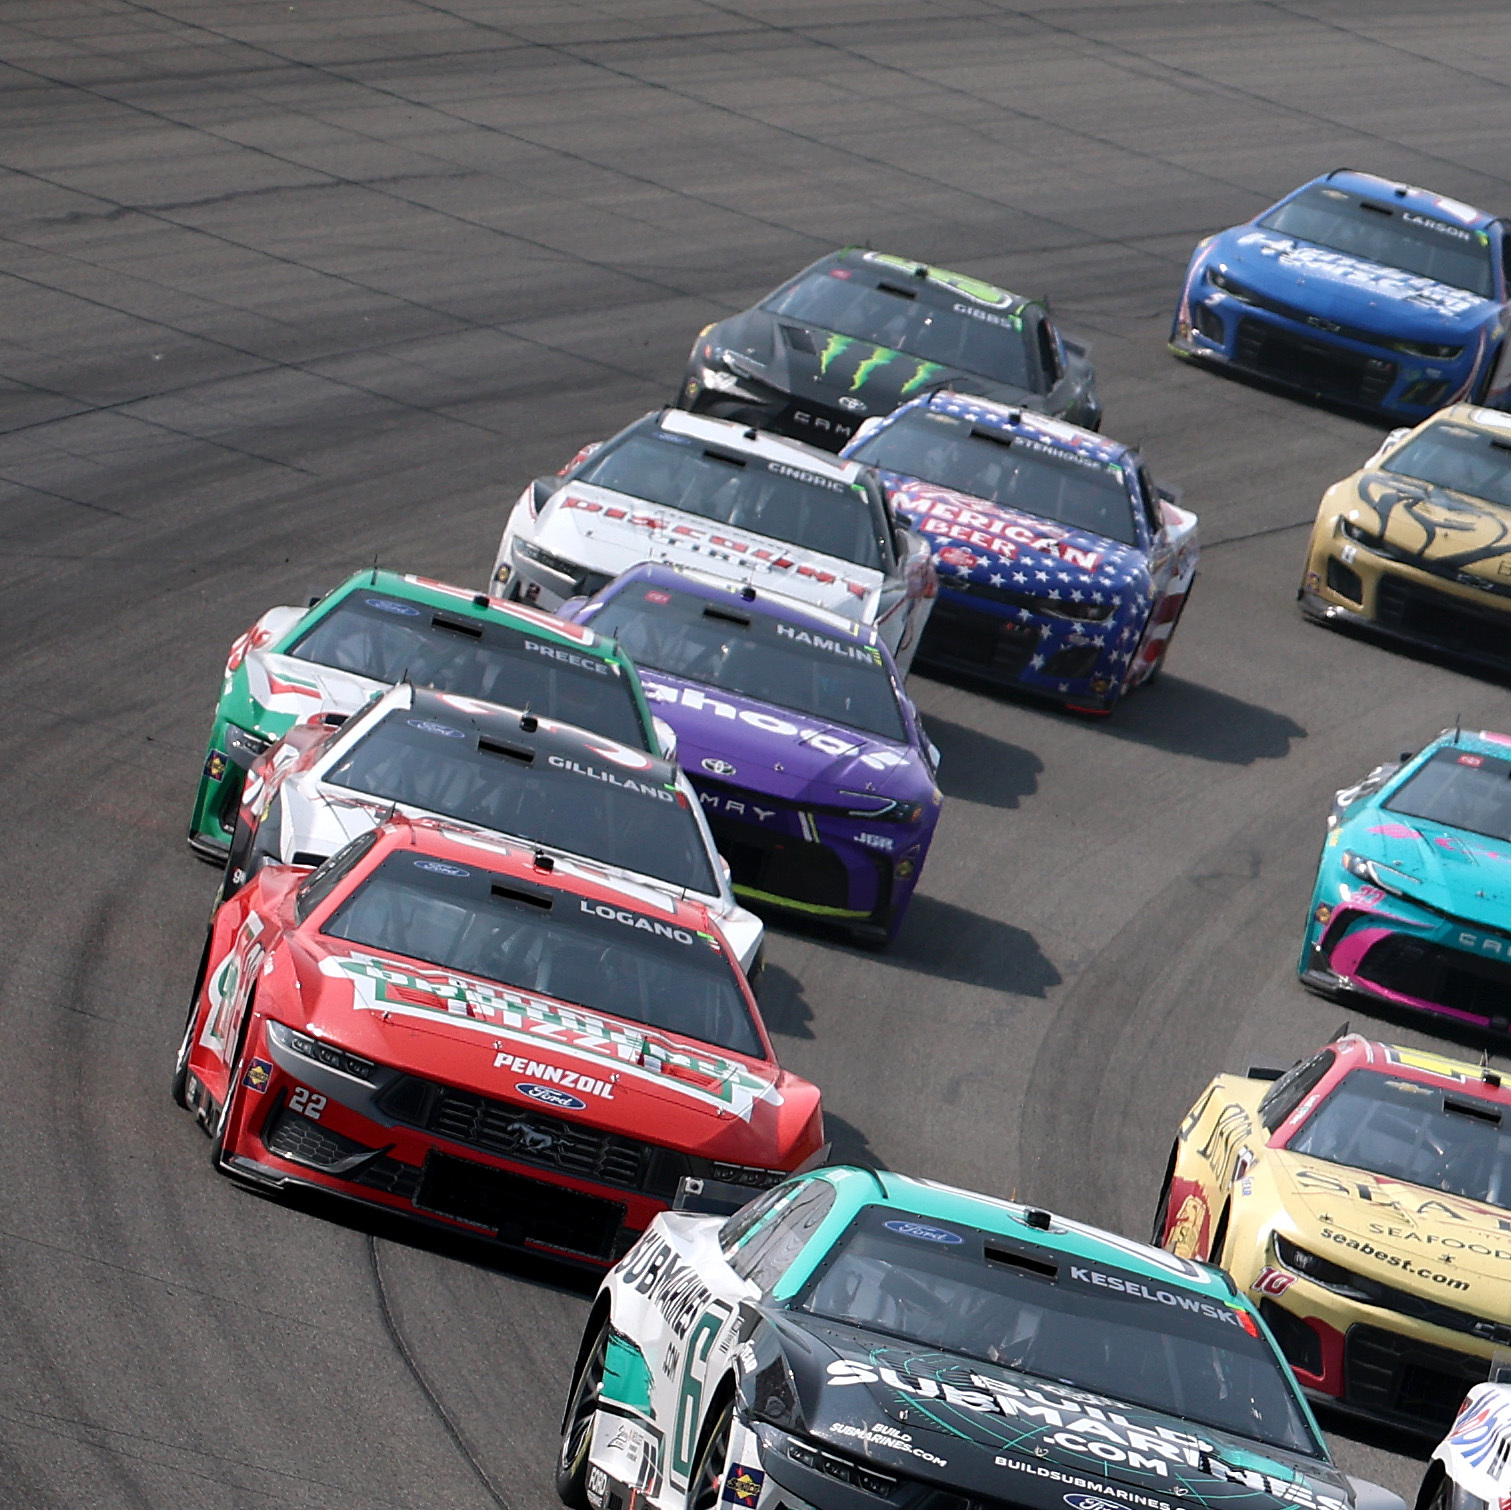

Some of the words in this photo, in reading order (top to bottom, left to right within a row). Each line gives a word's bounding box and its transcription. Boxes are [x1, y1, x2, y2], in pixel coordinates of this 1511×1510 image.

[1402, 211, 1470, 240] LARSON
[953, 303, 1012, 329] GIBBS
[794, 411, 853, 436] CAM
[767, 461, 845, 494] CINDRIC
[924, 518, 1018, 556] BEER
[524, 639, 609, 675] PREECE
[776, 624, 873, 664] HAMLIN
[548, 755, 674, 802] GILLILAND
[700, 793, 776, 821] MRY
[580, 899, 693, 946] LOGANO
[493, 1052, 616, 1100] PENNZOIL
[288, 1086, 328, 1120] 22
[1320, 1226, 1471, 1292] seabest.com
[1070, 1265, 1245, 1329] KESELOWSKI
[1249, 1265, 1300, 1299] 10
[671, 1298, 728, 1492] 6
[970, 1371, 1214, 1454] BUILD
[829, 1422, 948, 1469] SUBMARINES.COM
[871, 1421, 913, 1444] BUILD
[1043, 1429, 1169, 1478] .COM
